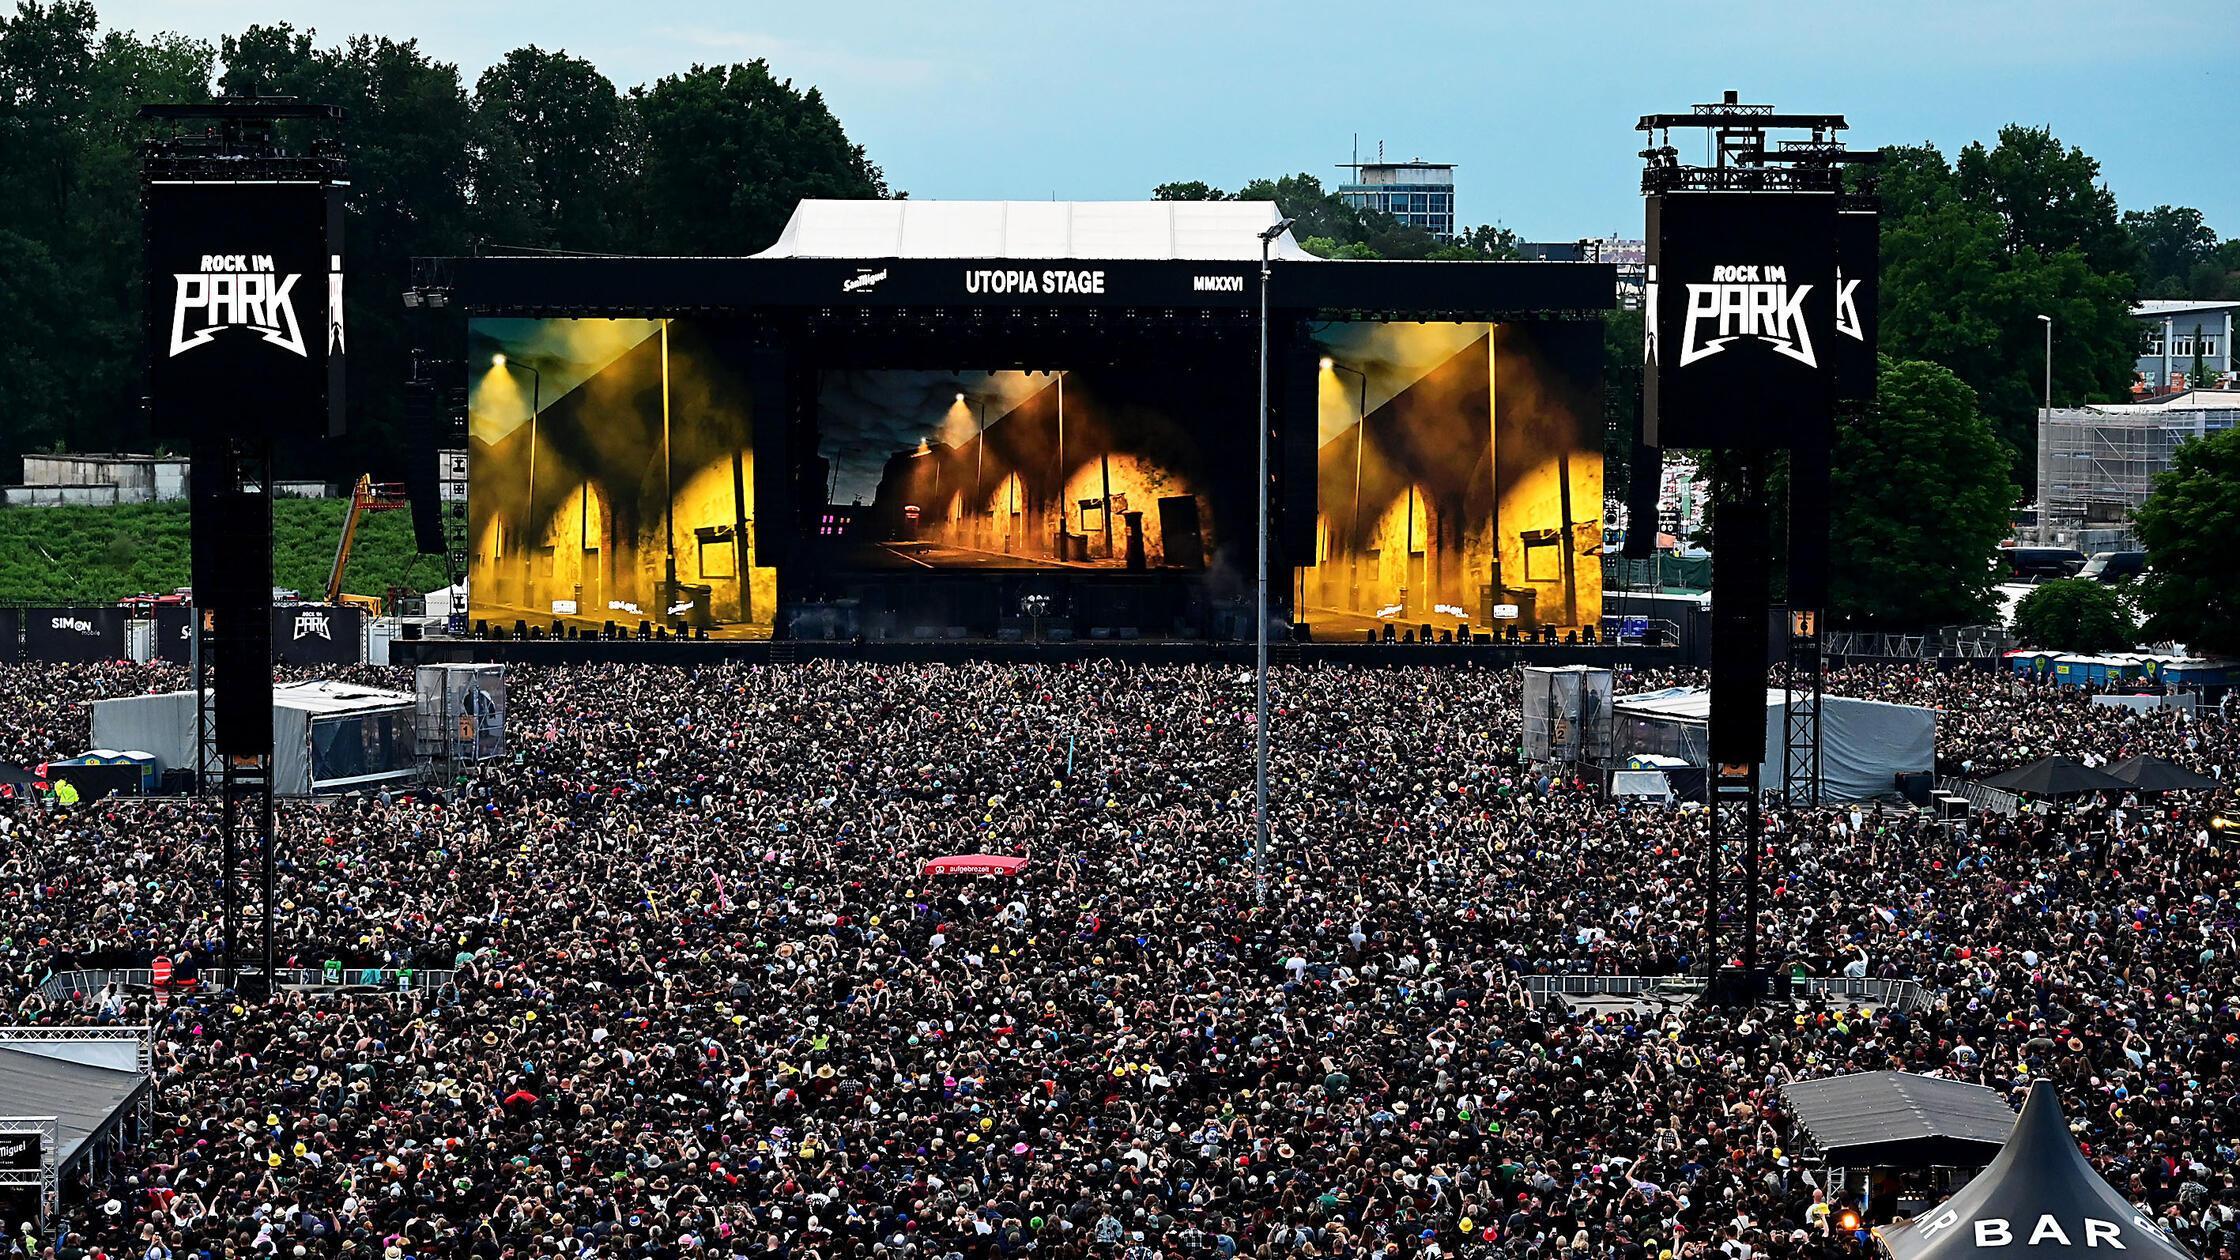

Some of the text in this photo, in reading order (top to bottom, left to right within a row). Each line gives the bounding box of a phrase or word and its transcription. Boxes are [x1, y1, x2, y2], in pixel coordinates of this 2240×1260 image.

[201, 255, 275, 272] ROCK IM
[1713, 265, 1787, 282] ROCK IM
[966, 270, 1105, 293] UTOPIA STAGE
[1193, 276, 1244, 292] MMXXVI
[169, 274, 308, 358] PARK
[1680, 284, 1818, 369] PARK
[293, 617, 331, 640] PARK
[1974, 1214, 2127, 1250] BAR
